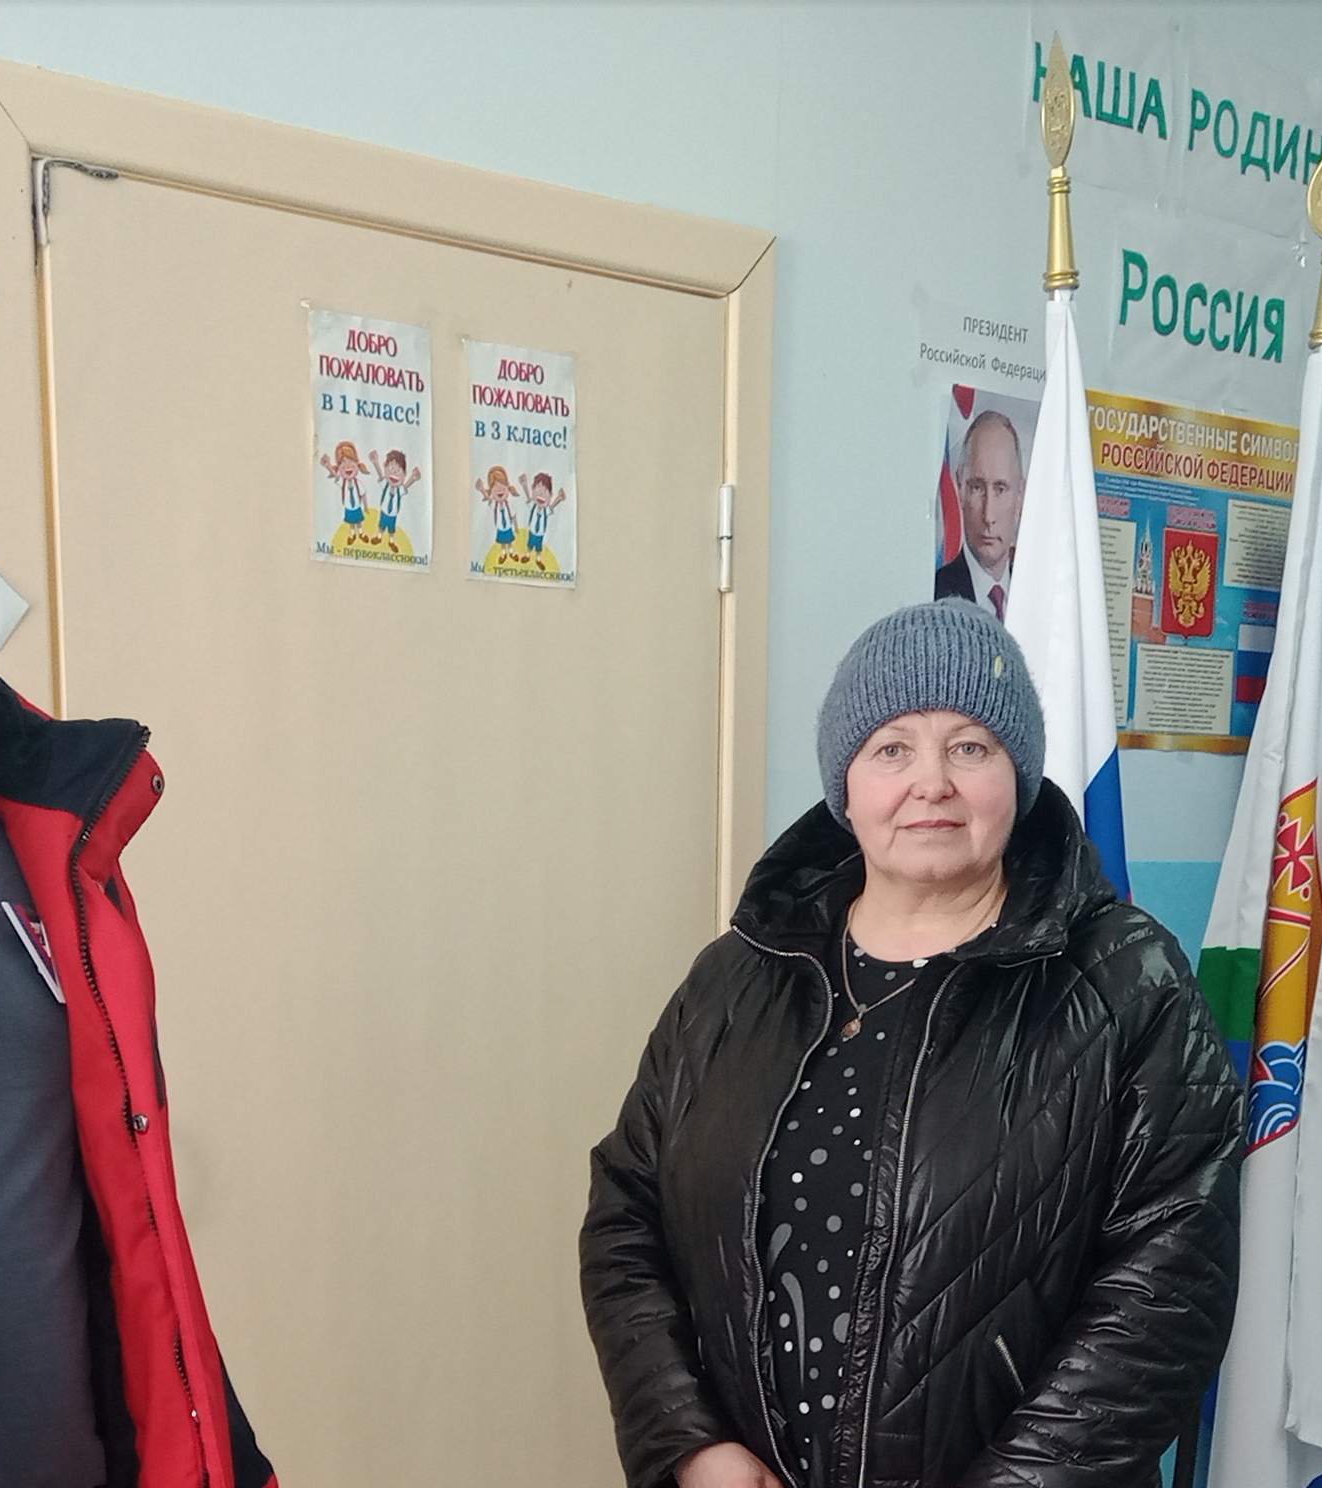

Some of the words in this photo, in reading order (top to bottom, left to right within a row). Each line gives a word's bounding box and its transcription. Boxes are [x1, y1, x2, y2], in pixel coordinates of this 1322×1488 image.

[346, 330, 398, 357] ДОБРО
[963, 317, 1029, 344] ПРЕЗИДЕНТ
[319, 354, 425, 392] ПОЖАЛОВАТЬ
[497, 359, 544, 385] ДОБРО
[920, 343, 986, 370] Российской
[991, 356, 1046, 383] Федераци
[340, 394, 349, 414] 1
[356, 398, 420, 426] класс!
[472, 384, 569, 418] ПОЖАЛОВАТЬ
[491, 420, 501, 440] 3
[507, 424, 567, 449] класс!
[1088, 404, 1238, 454] ГОСУДАРСТВЕННЫЕ
[1240, 433, 1300, 463] СИМВОЛ
[1101, 443, 1203, 479] РОССИЙСКОЙ
[1207, 459, 1295, 494] ФЕДЕРАЦИИ
[316, 542, 335, 554] Мы
[343, 547, 428, 567] первоклассники!
[470, 561, 485, 573] Мы
[493, 564, 575, 582] третьеклассники!
